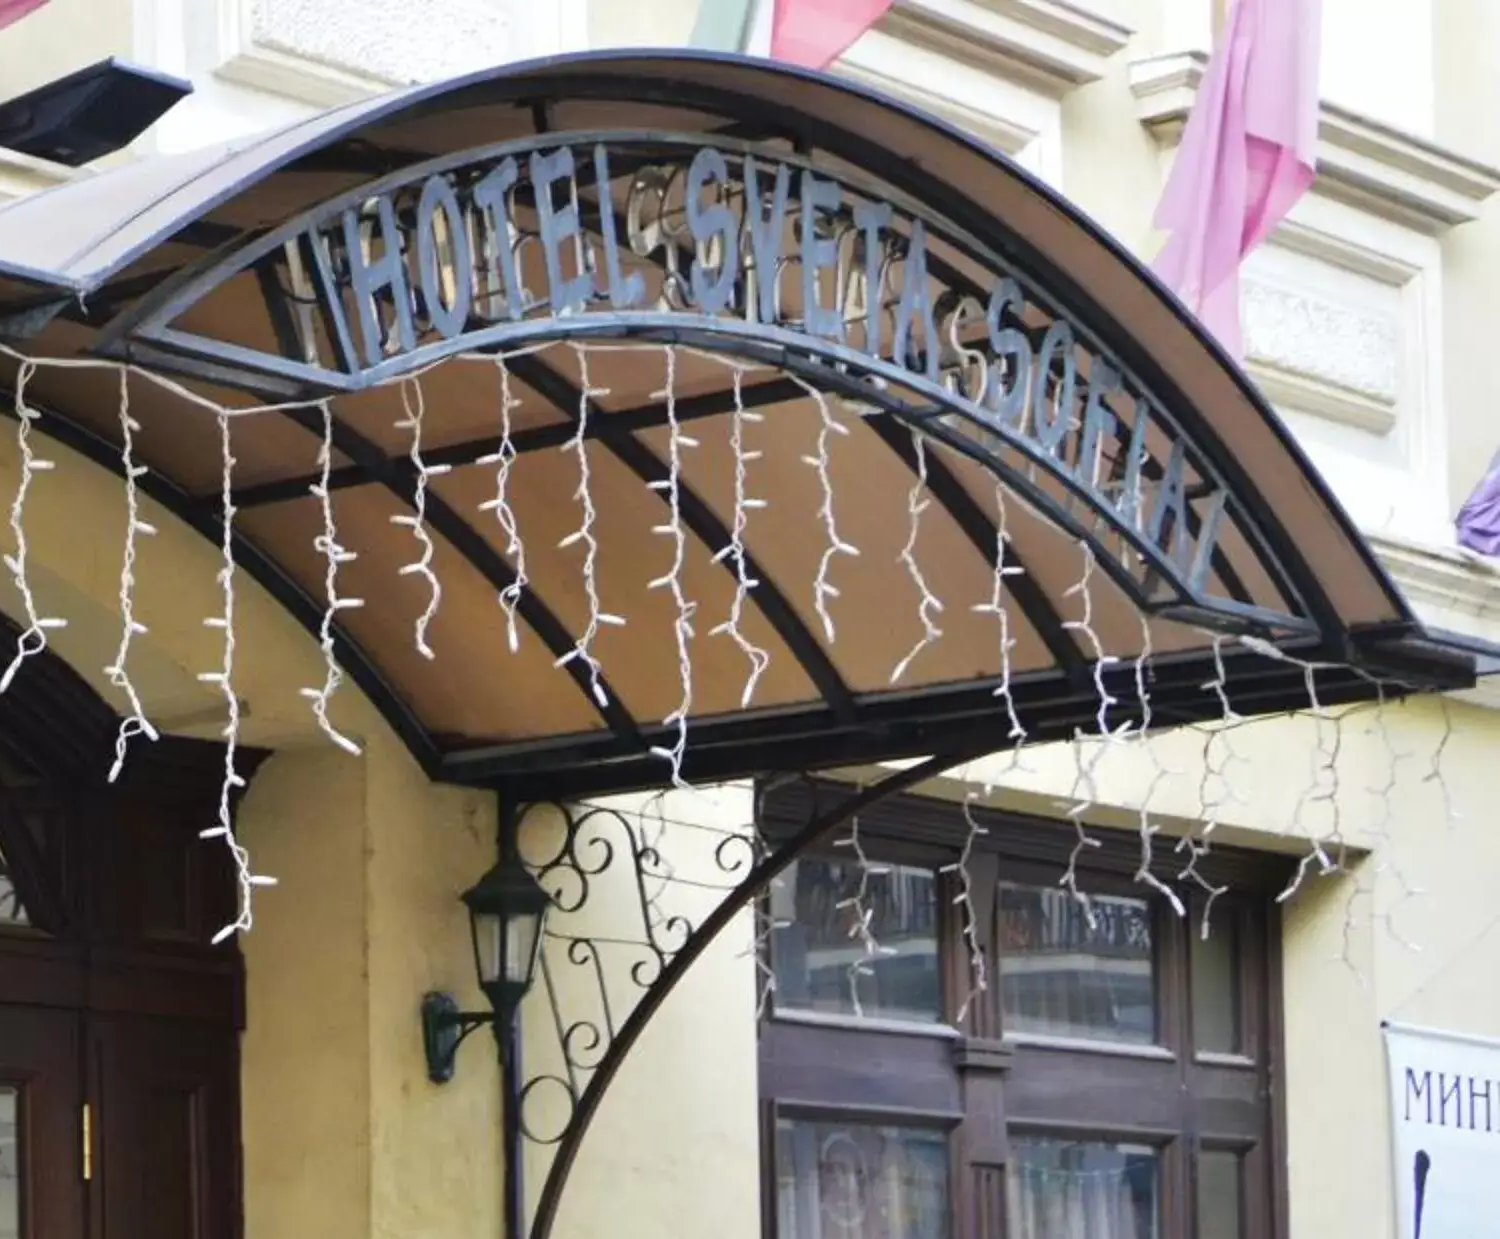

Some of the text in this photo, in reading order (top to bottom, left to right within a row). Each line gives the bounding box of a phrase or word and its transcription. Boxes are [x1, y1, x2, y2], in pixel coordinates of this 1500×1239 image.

[343, 144, 1190, 576] HOTEL SVETA SOFIA
[1405, 1066, 1500, 1134] МИН
